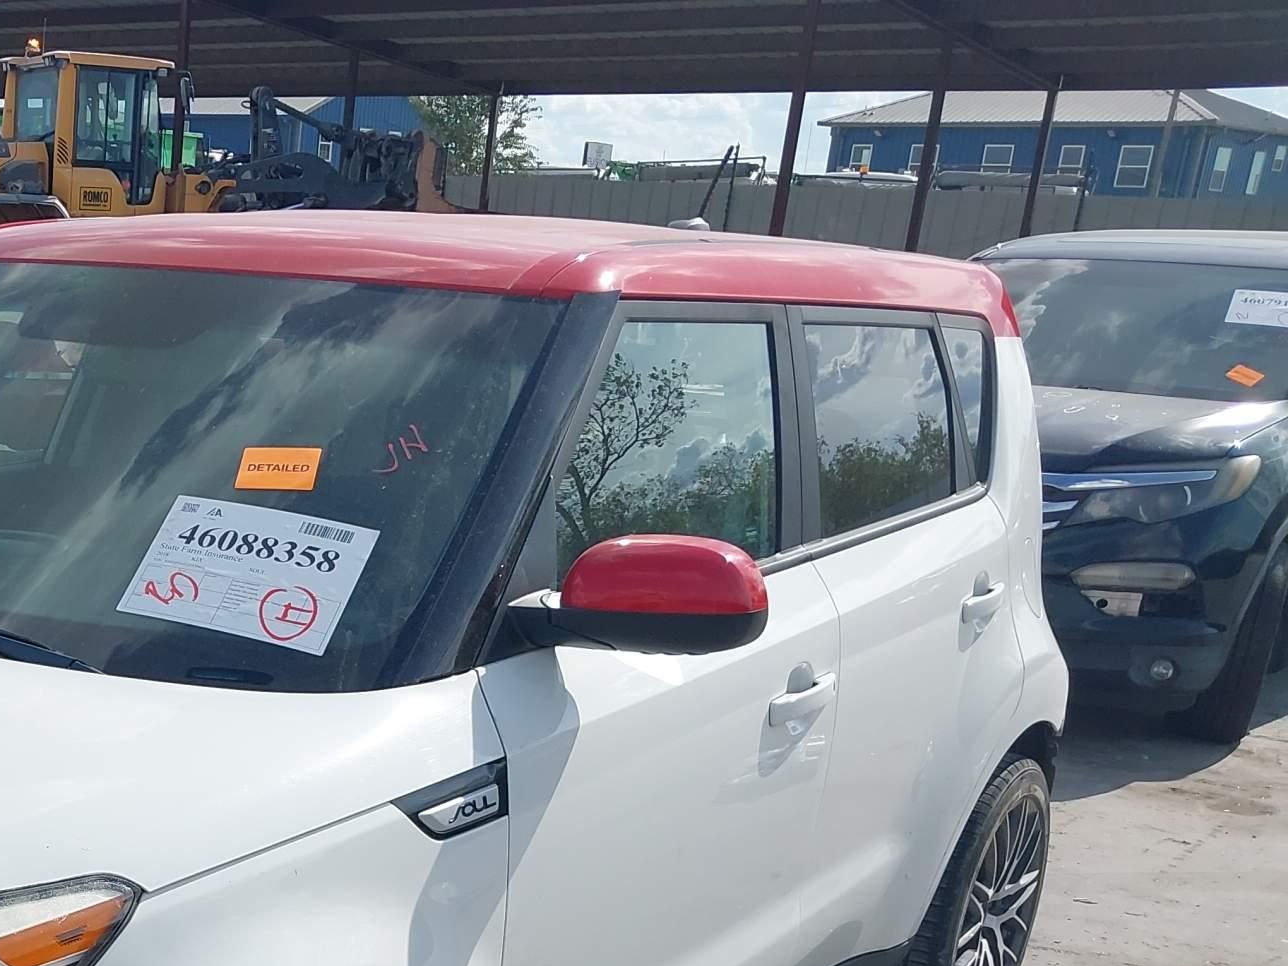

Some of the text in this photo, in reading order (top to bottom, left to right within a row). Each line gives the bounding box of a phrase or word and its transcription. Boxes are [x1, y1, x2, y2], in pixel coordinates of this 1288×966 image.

[82, 190, 109, 203] ROMCO
[247, 463, 310, 473] DETAILED
[160, 542, 180, 552] State
[181, 545, 202, 556] Farm
[203, 549, 244, 563] Insurance
[178, 524, 340, 572] 46088358
